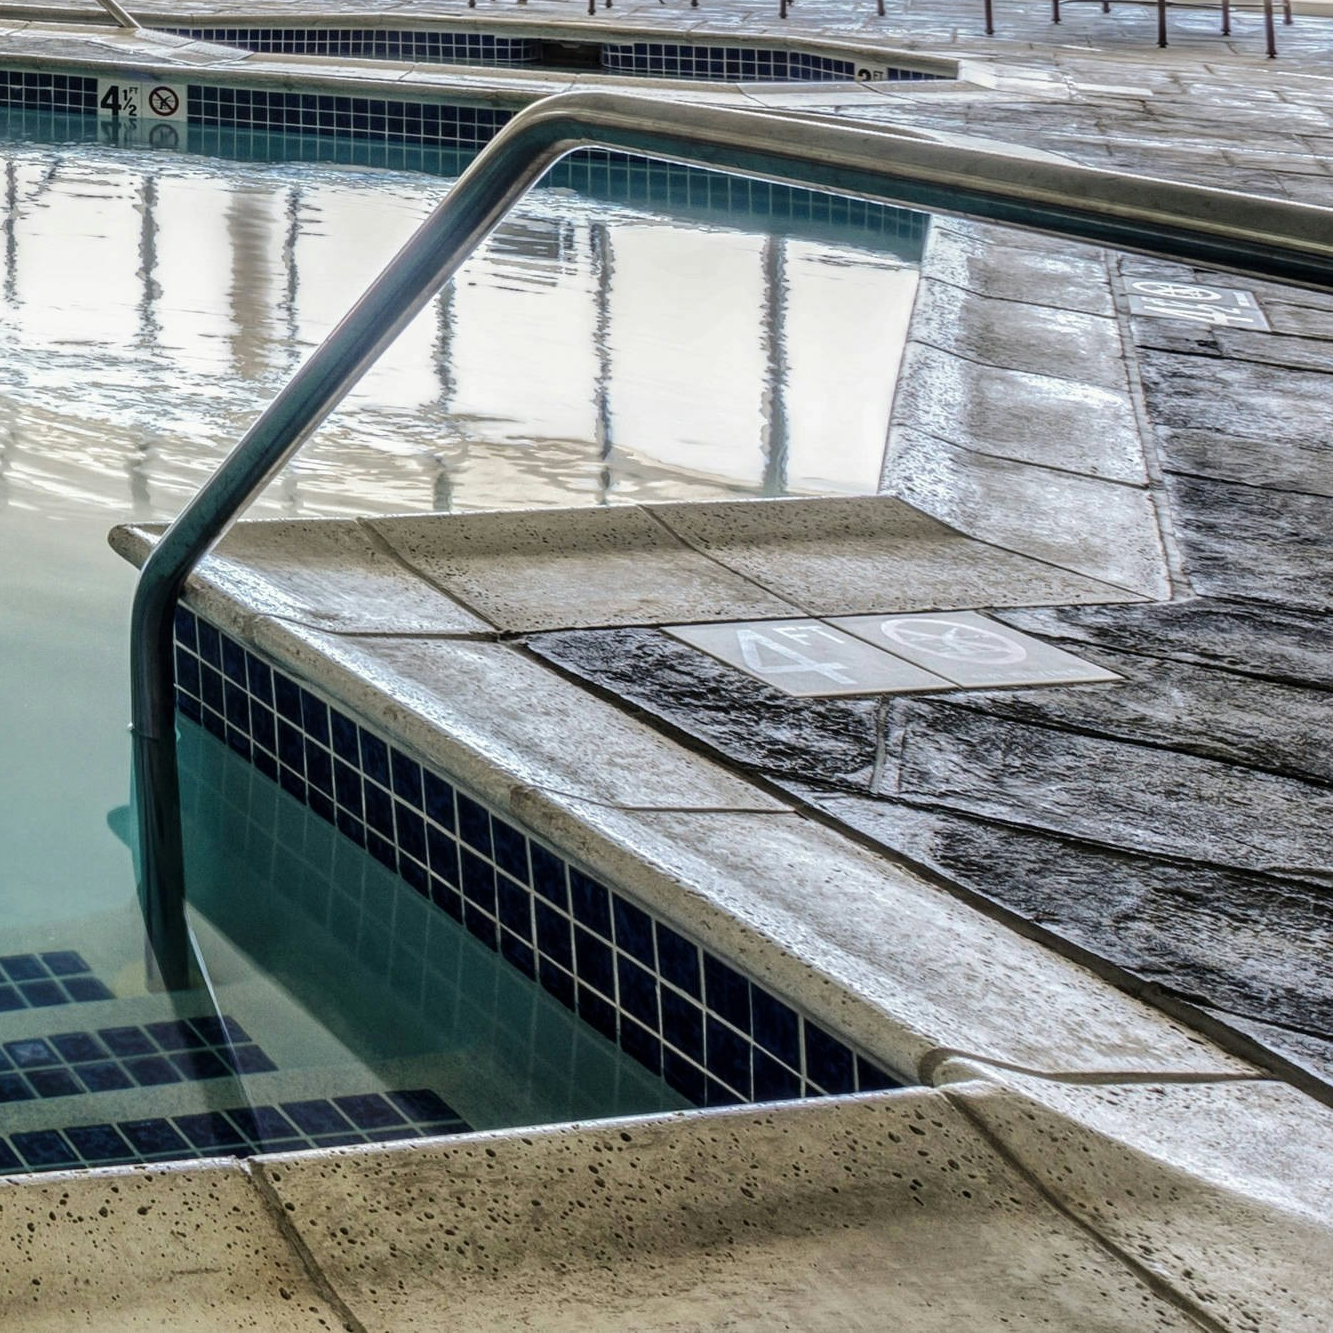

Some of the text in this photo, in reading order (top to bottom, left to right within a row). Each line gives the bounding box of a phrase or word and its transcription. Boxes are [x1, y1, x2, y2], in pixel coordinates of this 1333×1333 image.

[100, 85, 121, 116] 4
[737, 626, 857, 684] 4 FT
